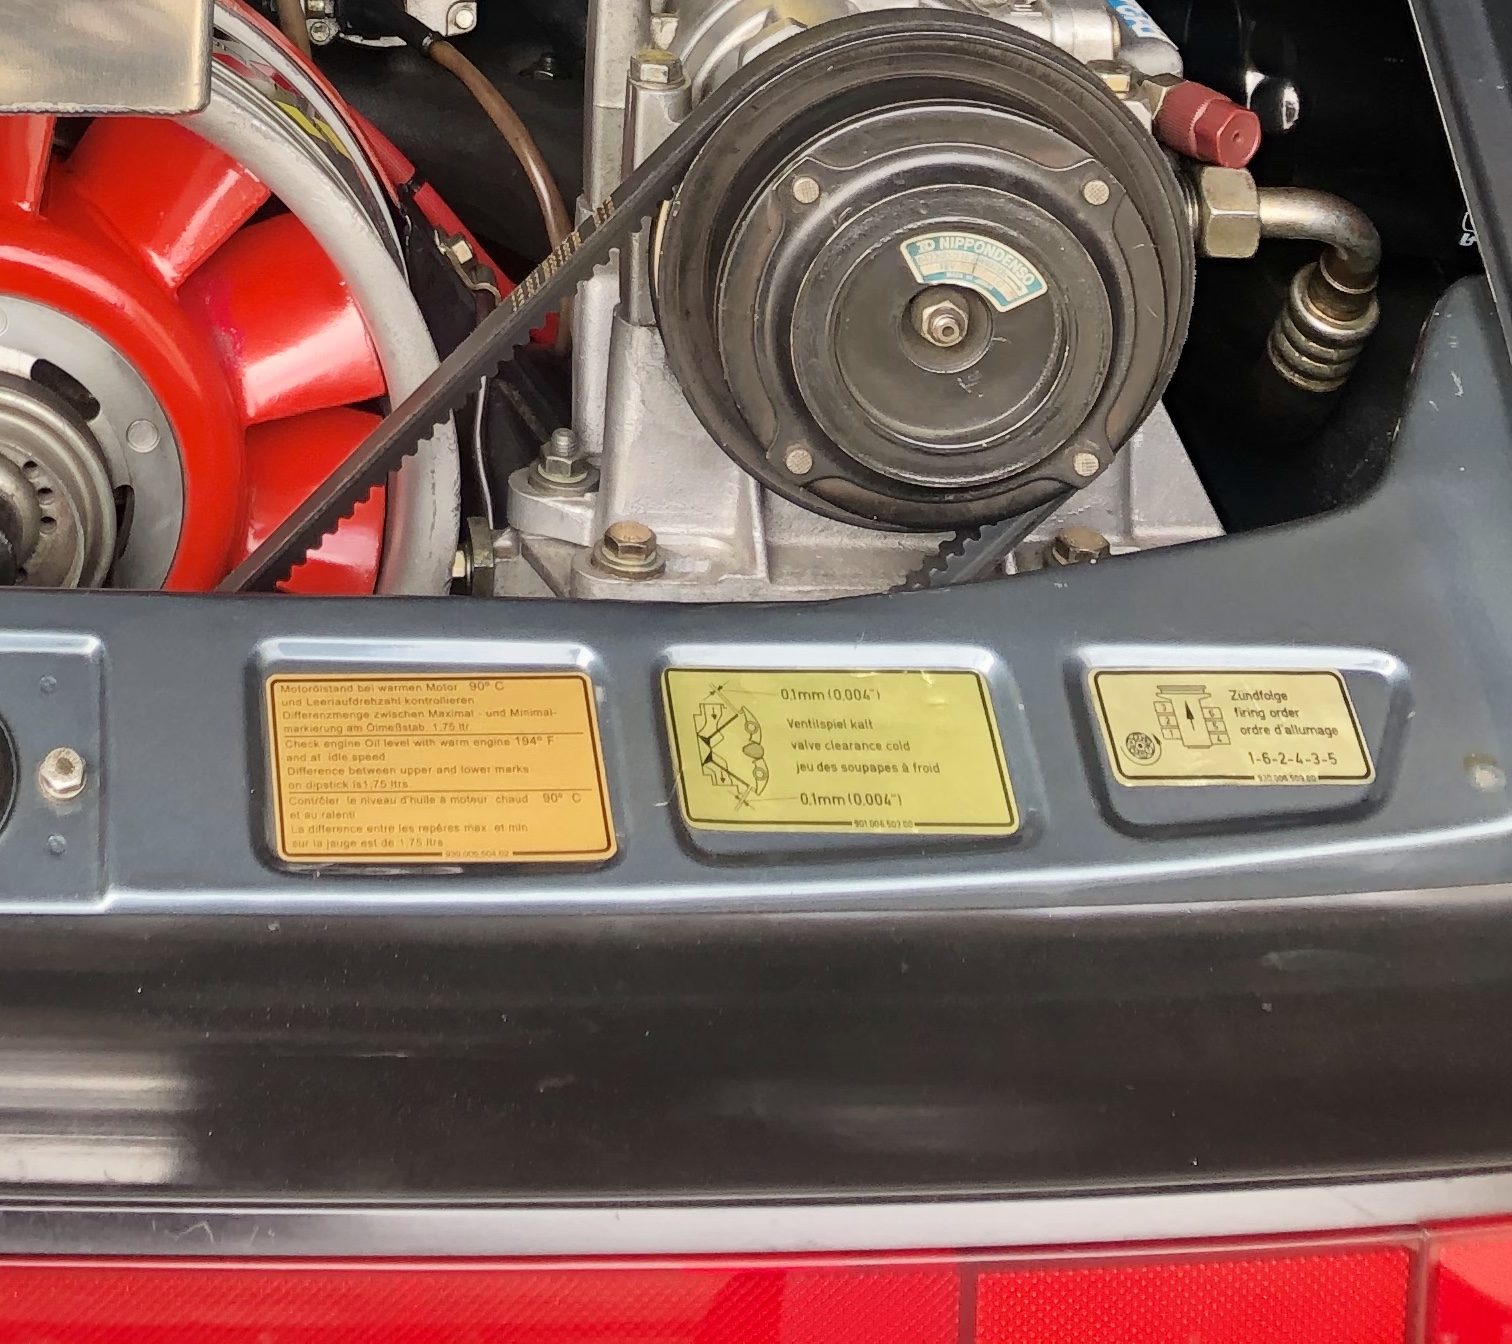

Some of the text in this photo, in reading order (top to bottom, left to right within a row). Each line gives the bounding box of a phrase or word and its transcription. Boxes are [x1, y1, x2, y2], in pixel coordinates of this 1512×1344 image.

[939, 237, 1036, 286] NIPPONDENSO
[357, 684, 375, 693] bei
[378, 683, 422, 692] warmen
[426, 683, 457, 692] Motor
[494, 681, 505, 691] C
[281, 696, 474, 707] und Leerlaufdrehzahl kontrollieren
[1228, 689, 1288, 703] Zündfolge
[283, 711, 370, 721] Differenzmenge
[374, 710, 424, 719] zwischen
[486, 709, 506, 717] und
[1234, 707, 1300, 720] firing order
[787, 718, 873, 731] Ventilspiel kalt
[1165, 716, 1170, 725] 2
[284, 724, 343, 734] markierung
[1169, 730, 1173, 738] 1
[1240, 724, 1338, 738] ordre d'allumage
[285, 739, 319, 748] Check
[324, 739, 360, 749] engine
[365, 738, 380, 747] Oil
[384, 738, 409, 747] level
[414, 739, 435, 747] with
[440, 739, 469, 747] warm
[473, 738, 510, 748] engine
[547, 736, 554, 745] F
[791, 740, 910, 752] valve clearance cold
[287, 753, 386, 763] and at idle speed
[1248, 752, 1338, 765] 1-6-2-4-3-5
[288, 765, 529, 776] Difference between upper and lower marks
[796, 761, 940, 775] jeu des soupapes à froid
[288, 781, 349, 790] on dipstick
[289, 795, 339, 806] Contrôler
[347, 795, 356, 805] le
[361, 795, 396, 805] niveau
[400, 795, 436, 804] d'huile
[450, 796, 488, 804] moteur
[495, 795, 529, 804] chaud
[572, 793, 581, 804] C
[290, 811, 300, 819] et
[291, 823, 504, 834] La entre les et
[292, 838, 394, 850] sur la jauge est de
